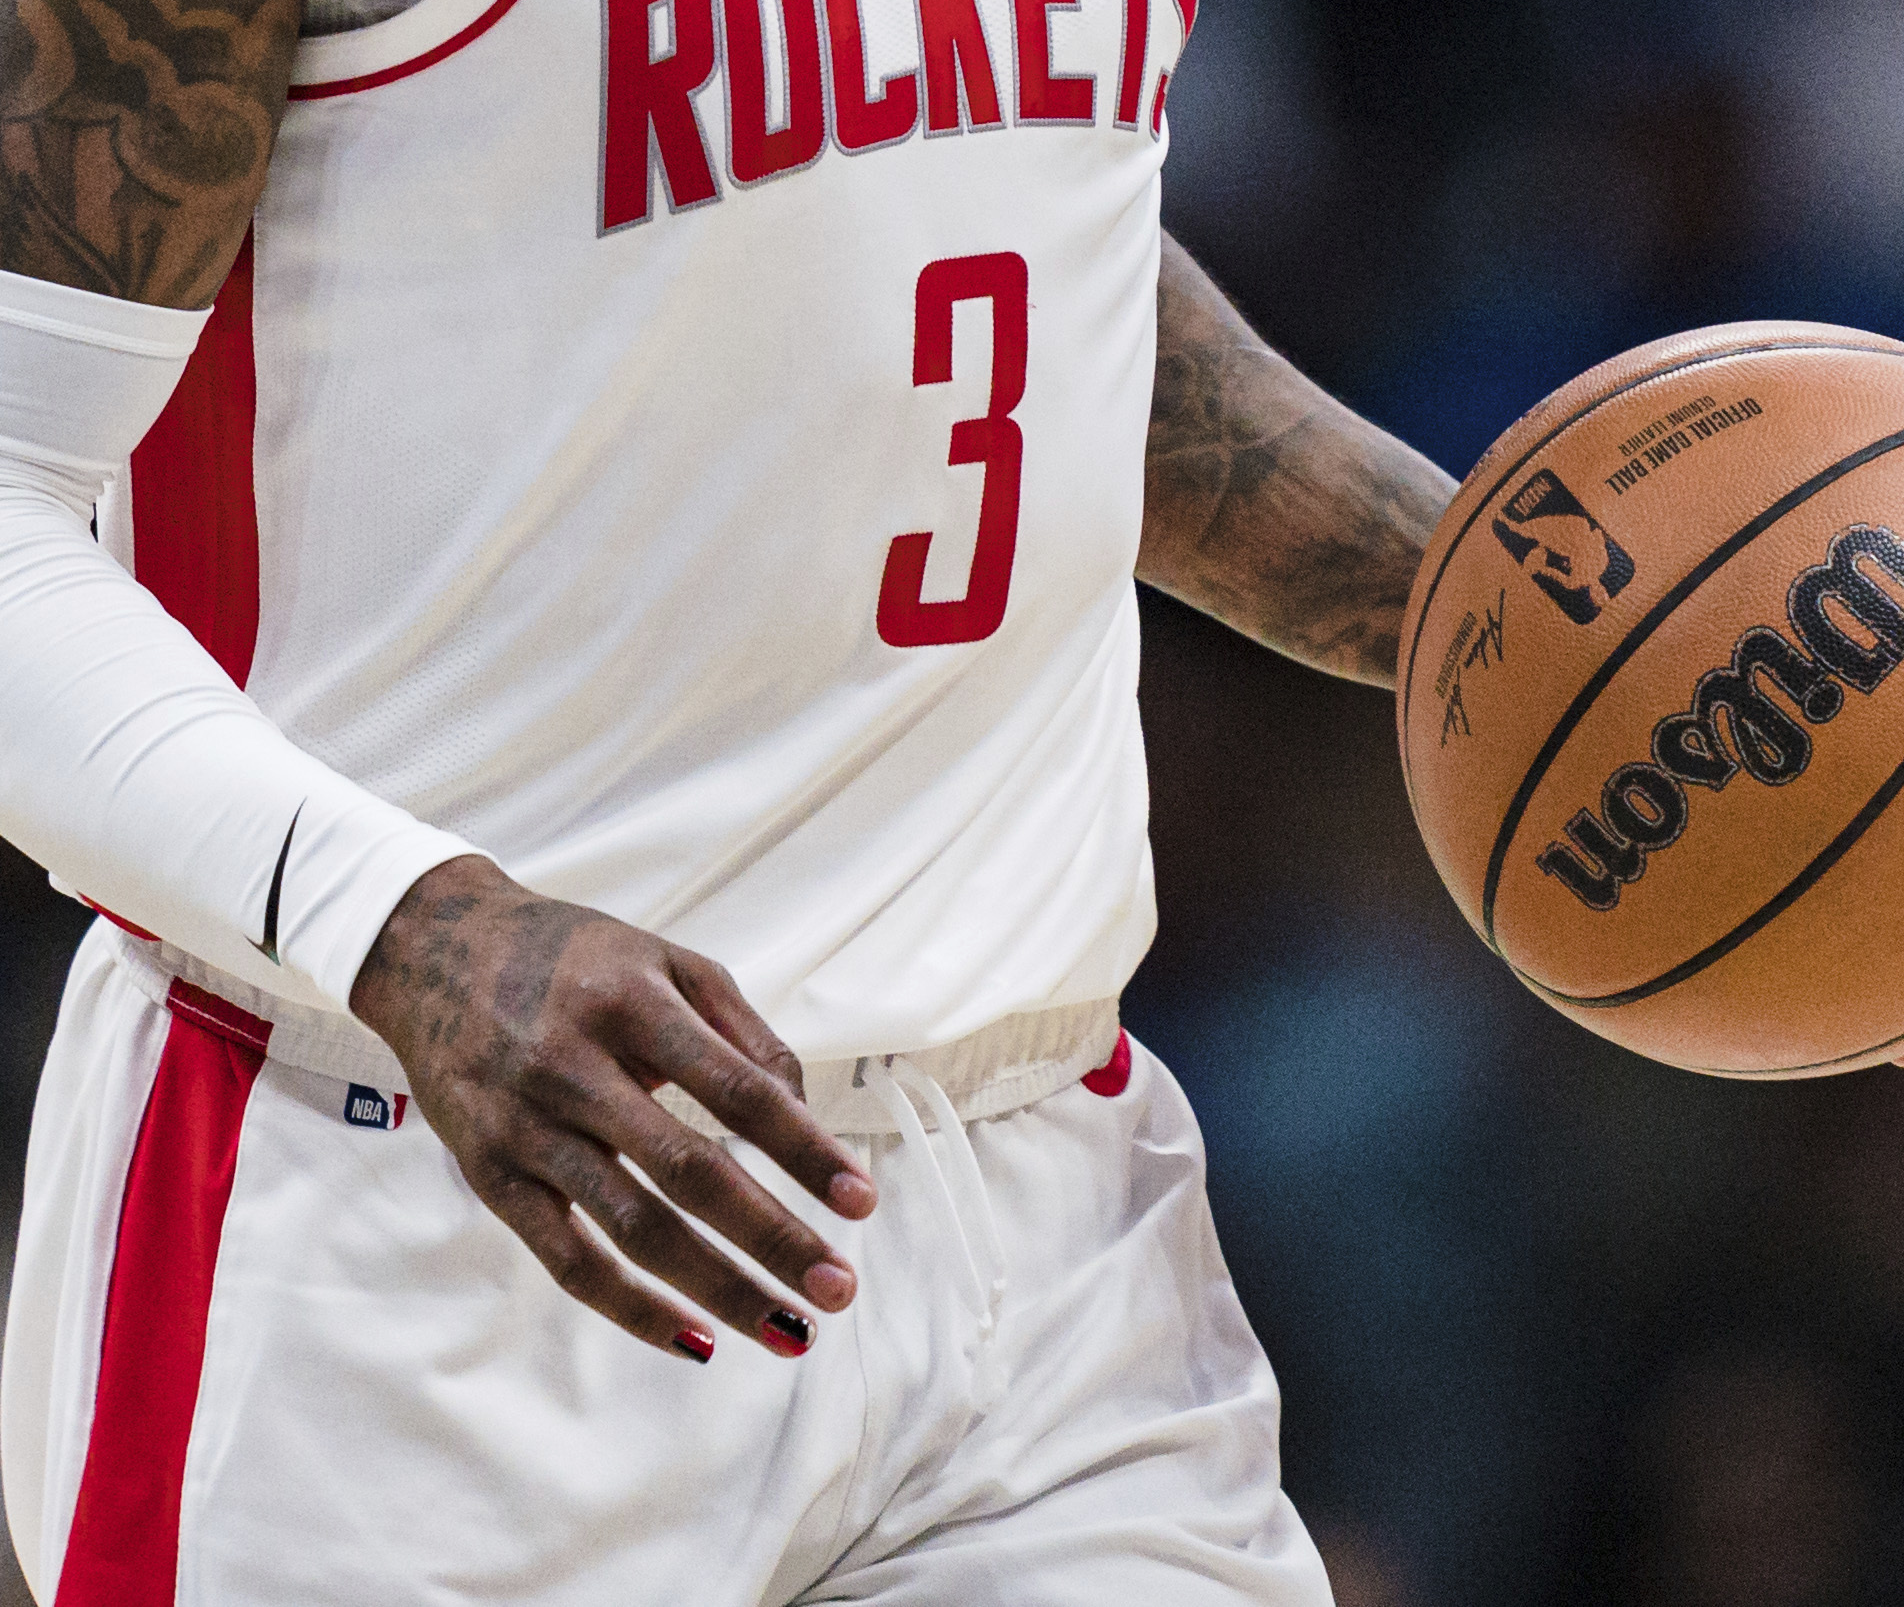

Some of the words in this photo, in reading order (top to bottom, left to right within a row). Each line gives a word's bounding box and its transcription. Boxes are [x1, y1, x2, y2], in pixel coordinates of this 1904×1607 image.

[1665, 395, 1716, 428] GENUINE
[1686, 397, 1763, 441] OFFICIAL
[877, 251, 1028, 648] 3
[1618, 419, 1669, 458] LEATHER
[1641, 430, 1693, 470] GAME
[1604, 458, 1650, 496] BALL
[351, 1098, 383, 1123] NBA
